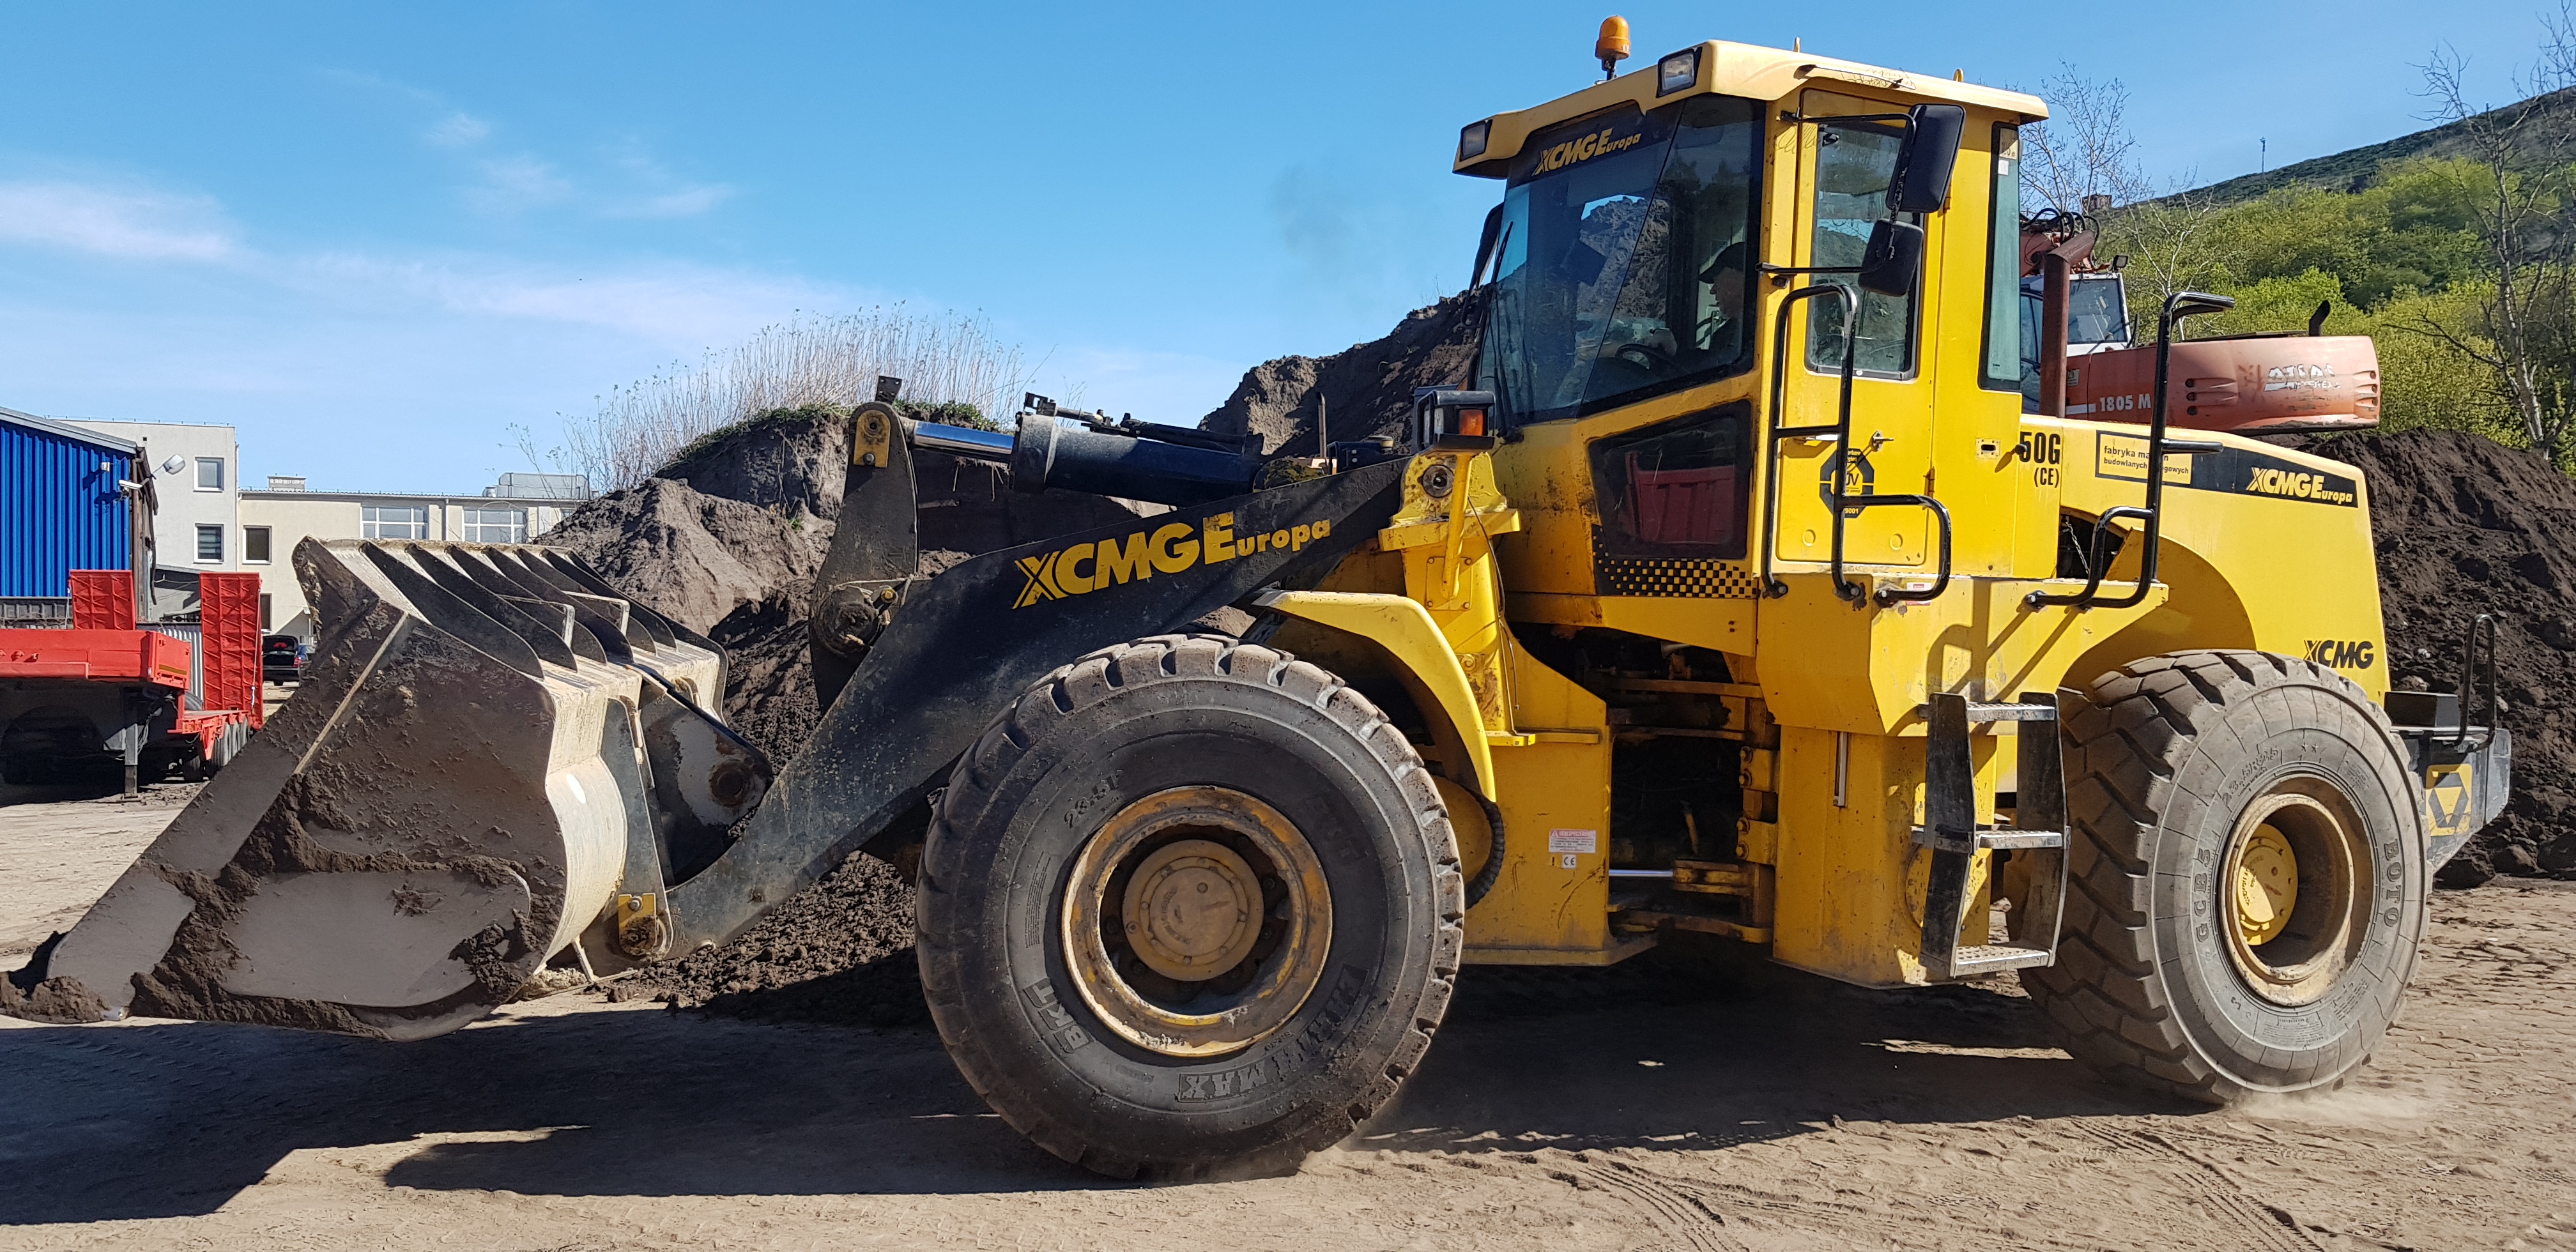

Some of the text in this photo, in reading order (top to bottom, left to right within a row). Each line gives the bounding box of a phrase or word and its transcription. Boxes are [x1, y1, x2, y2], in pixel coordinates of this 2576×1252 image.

[2099, 393, 2152, 412] 1805 M
[2019, 431, 2061, 465] 50G
[2104, 445, 2136, 458] fabryka
[2103, 457, 2147, 470] budowlanych
[2034, 467, 2060, 488] (CE)
[2303, 639, 2374, 669] XCMG
[1563, 857, 1575, 866] CE
[2384, 839, 2402, 927] BOTO
[1032, 985, 1089, 1050] BKT
[1182, 1060, 1268, 1099] MAX
